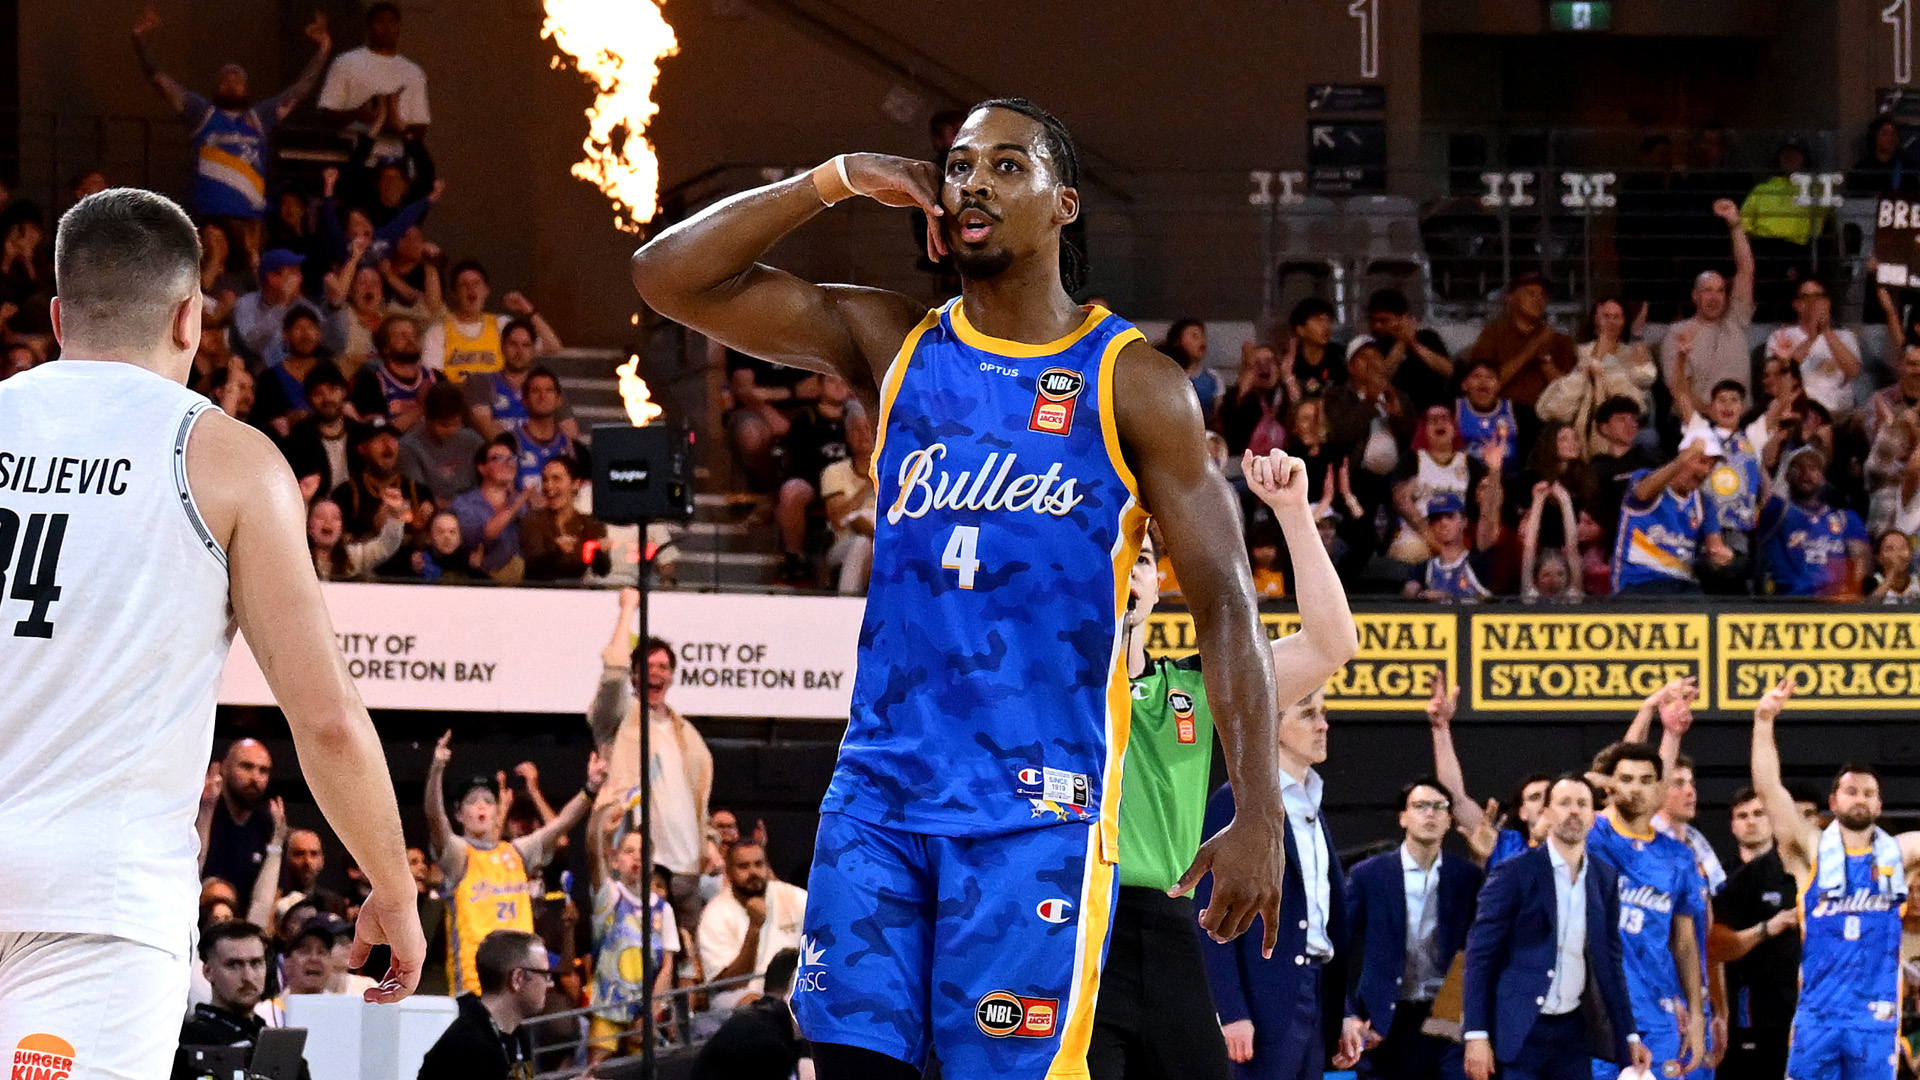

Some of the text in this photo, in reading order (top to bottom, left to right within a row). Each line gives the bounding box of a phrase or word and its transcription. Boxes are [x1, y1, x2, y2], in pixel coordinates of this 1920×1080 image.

[980, 362, 1020, 377] OPTUS
[1046, 374, 1074, 391] NBL
[0, 452, 131, 496] SILJEVIC
[887, 443, 1084, 525] Bullets
[941, 525, 980, 590] 4
[385, 634, 417, 655] OF
[1482, 622, 1700, 651] NATIONAL
[1728, 622, 1920, 651] NATIONA
[680, 642, 769, 664] CITY OF
[348, 658, 498, 682] ORETON BAY
[680, 667, 845, 690] MORETON BAY
[1324, 663, 1440, 697] RAGE
[1618, 905, 1645, 935] 13
[985, 1003, 1013, 1024] NBL
[13, 1050, 73, 1072] BURGER
